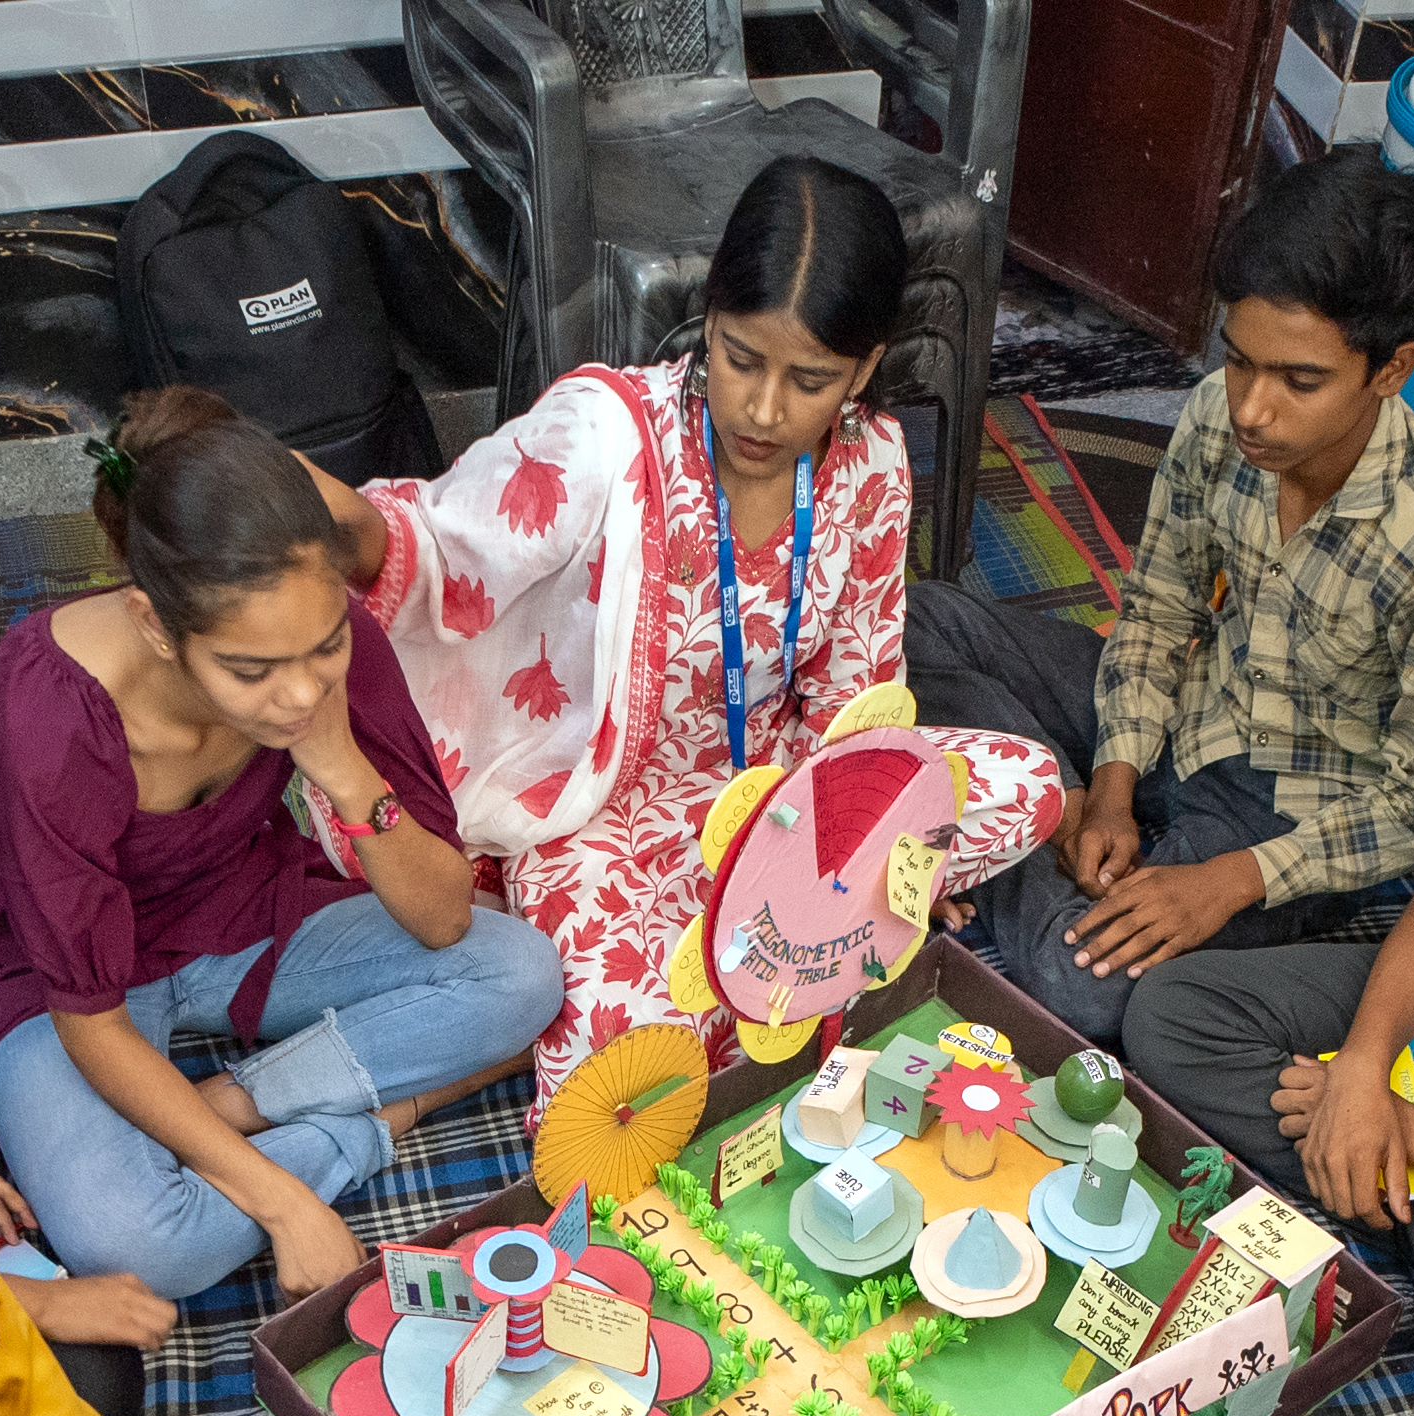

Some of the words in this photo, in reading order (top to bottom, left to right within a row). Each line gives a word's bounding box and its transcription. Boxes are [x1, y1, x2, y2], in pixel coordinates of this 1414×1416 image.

[270, 287, 310, 310] PLAN
[249, 308, 323, 336] www.planindia.org
[752, 900, 875, 966] TRIGONOMETRIC
[794, 960, 842, 986] TABLE
[939, 1030, 1012, 1064] HEMISPHERE
[826, 1060, 841, 1073] AM
[904, 1053, 931, 1075] 2
[882, 1095, 908, 1116] 4
[835, 1168, 863, 1192] CUBE
[620, 1208, 669, 1238] 10
[1259, 1218, 1288, 1244] Enjoy
[1237, 1222, 1256, 1240] this
[1254, 1239, 1282, 1261] table
[1242, 1244, 1264, 1261] ride
[670, 1249, 707, 1276] 9
[1080, 1278, 1103, 1305] Don't
[1098, 1270, 1155, 1319] WARNING
[716, 1292, 753, 1324] 8
[1077, 1298, 1099, 1319] any
[769, 1337, 797, 1364] 7
[1076, 1318, 1133, 1367] PLEASE!
[563, 1392, 581, 1409] you
[595, 1408, 608, 1416] the
